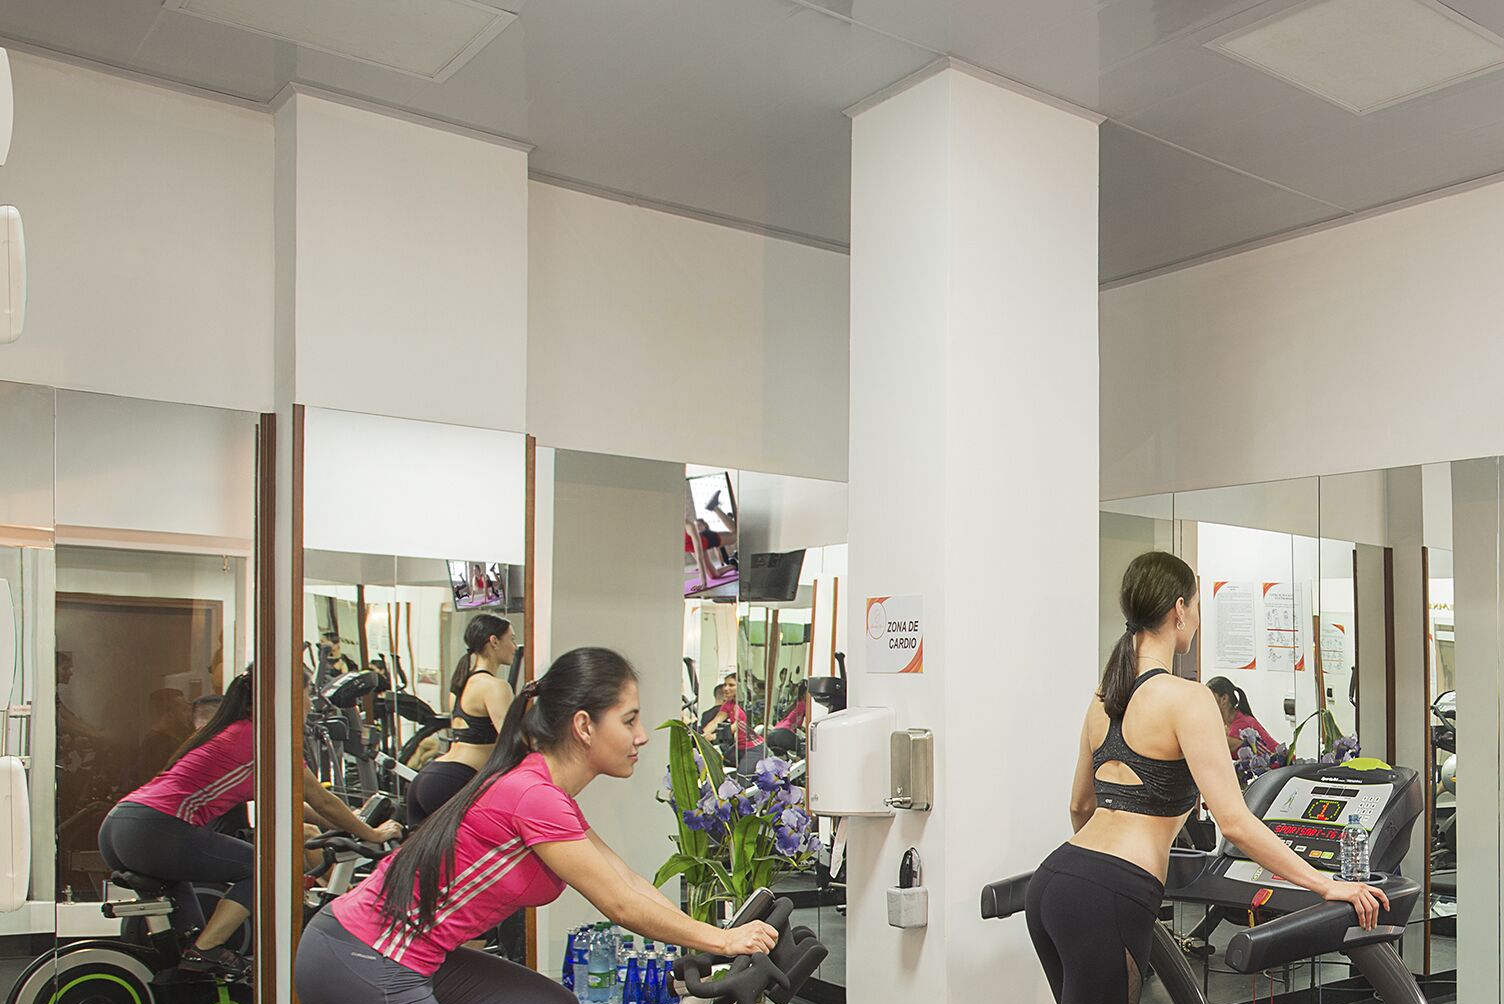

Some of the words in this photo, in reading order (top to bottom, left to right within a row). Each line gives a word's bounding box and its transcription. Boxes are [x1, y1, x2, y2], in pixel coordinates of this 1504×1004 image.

[887, 621, 907, 632] ZONA
[908, 620, 919, 632] DE
[888, 637, 917, 649] CARDIO
